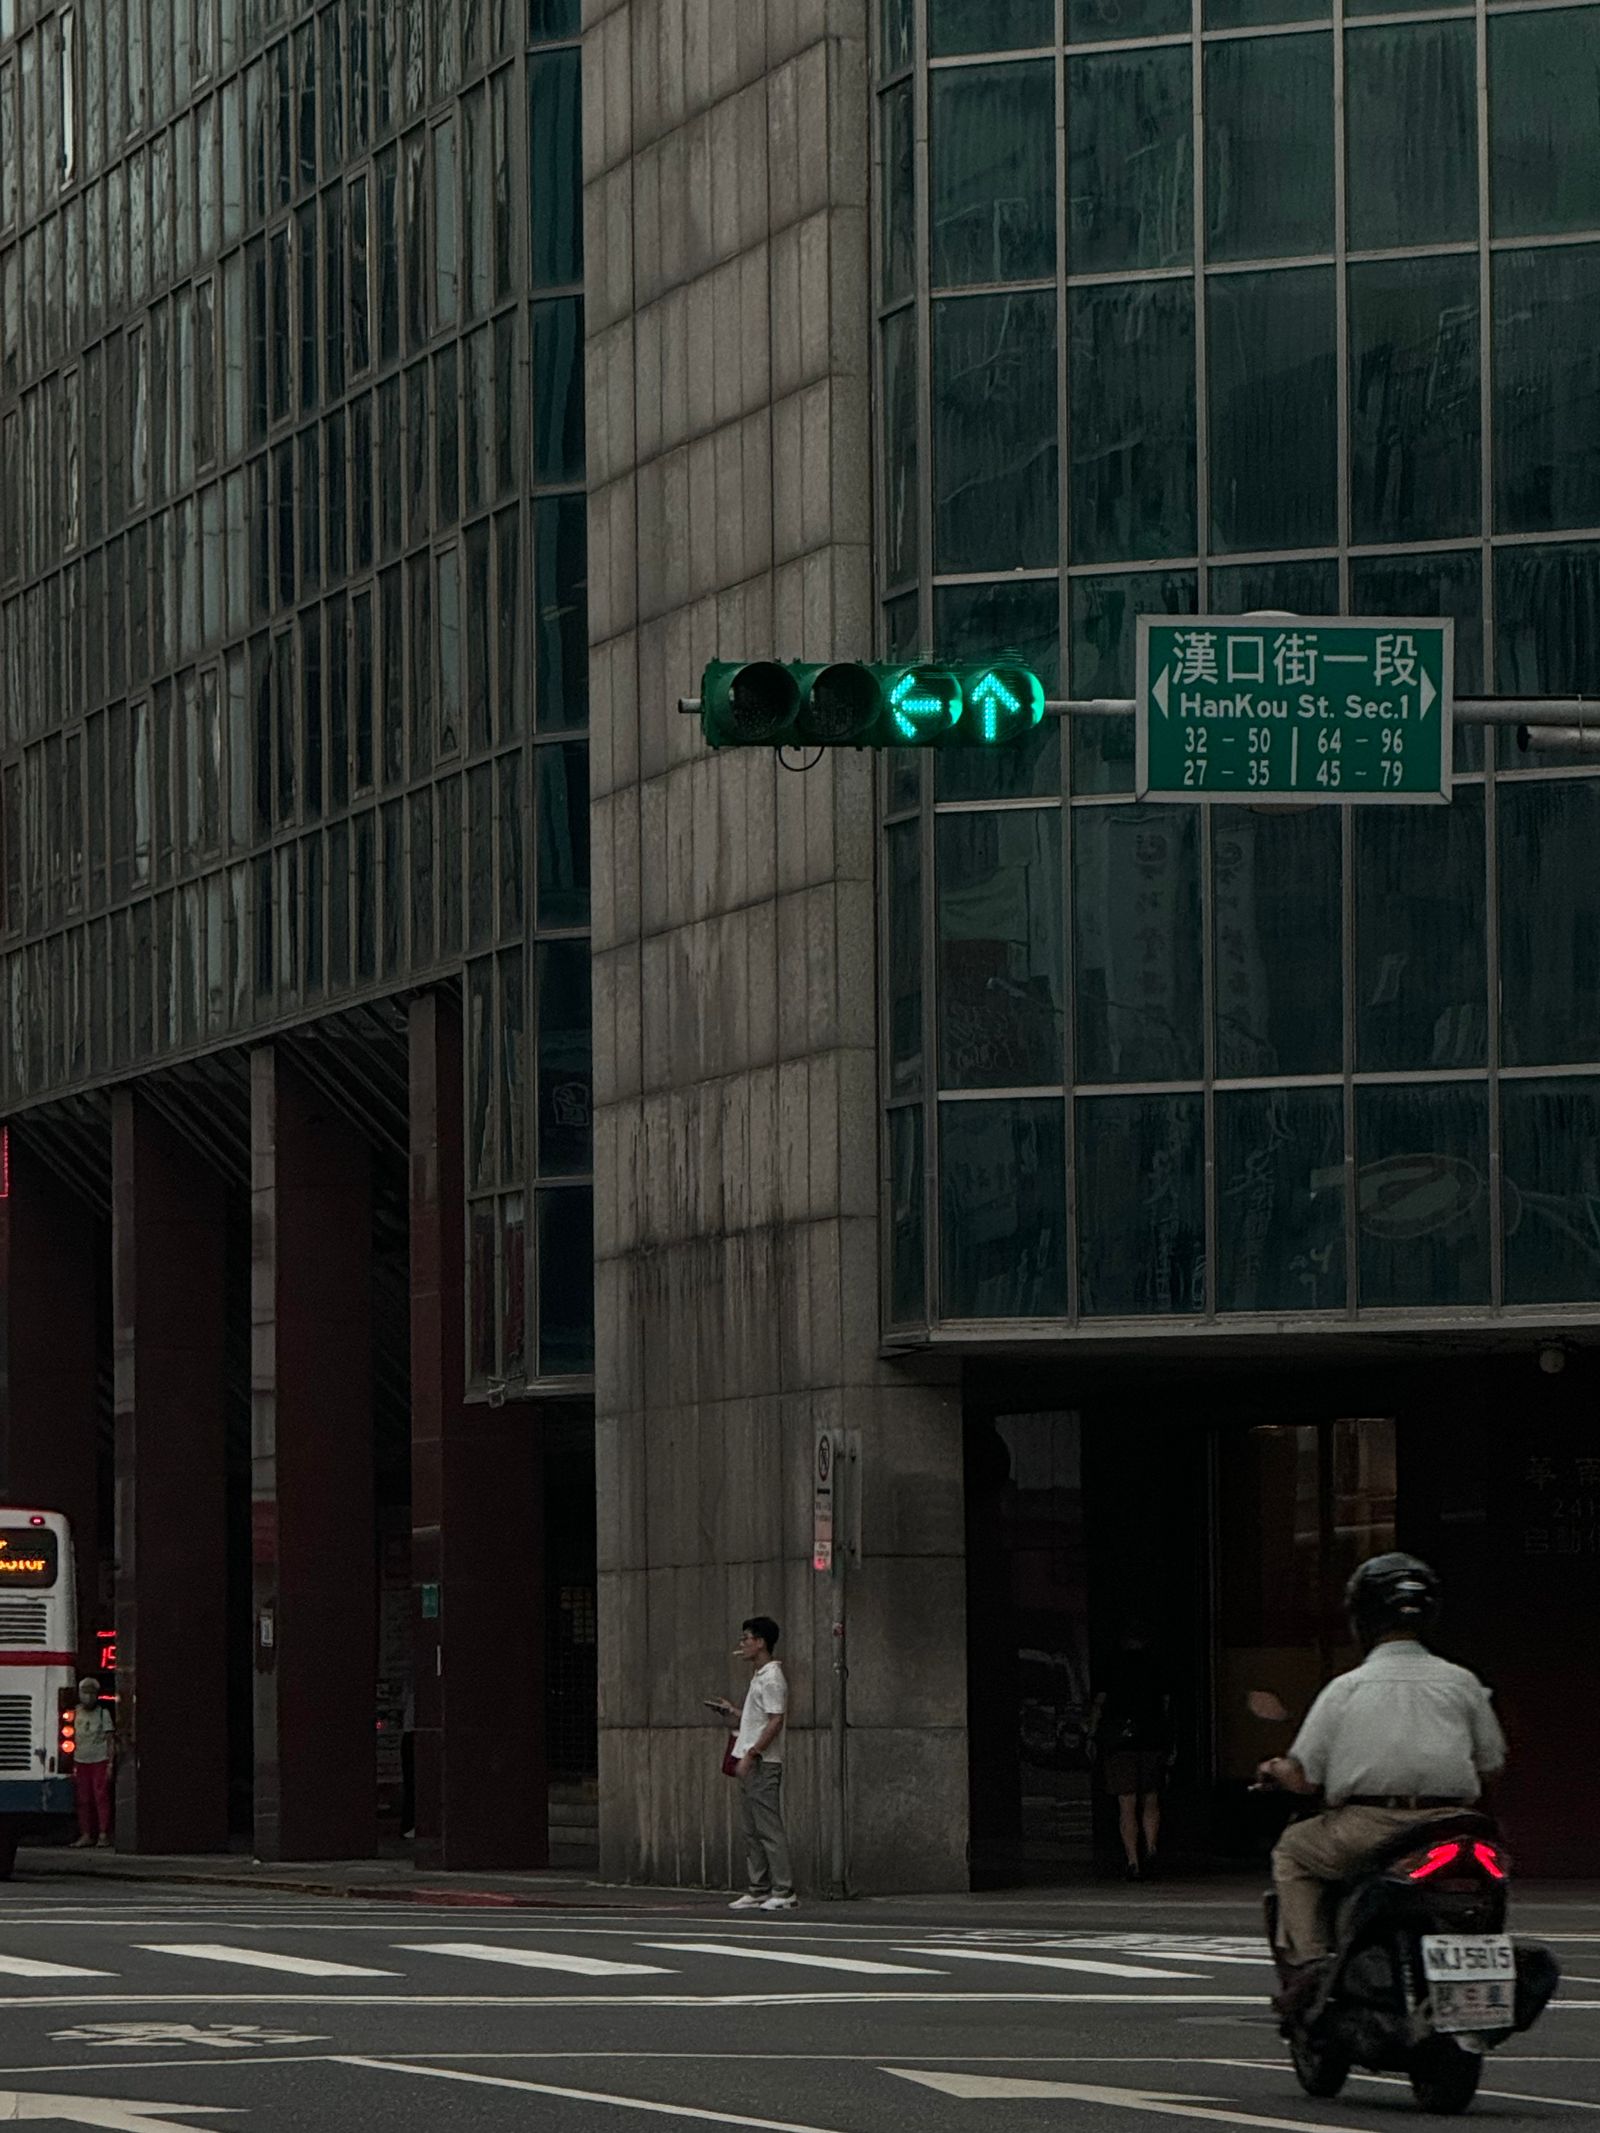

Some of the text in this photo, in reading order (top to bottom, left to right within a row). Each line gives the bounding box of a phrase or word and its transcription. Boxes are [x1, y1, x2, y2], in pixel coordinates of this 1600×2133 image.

[1172, 631, 1418, 686] 漢口街一段
[1180, 692, 1287, 718] HanKou
[1297, 694, 1335, 718] St.
[1185, 726, 1207, 753] 32
[1247, 727, 1270, 753] 50
[1317, 727, 1341, 754] 64
[1381, 727, 1403, 754] 96
[1184, 759, 1207, 785] 27
[1247, 759, 1269, 786] 35
[1316, 760, 1340, 786] 45
[1380, 760, 1403, 787] 79
